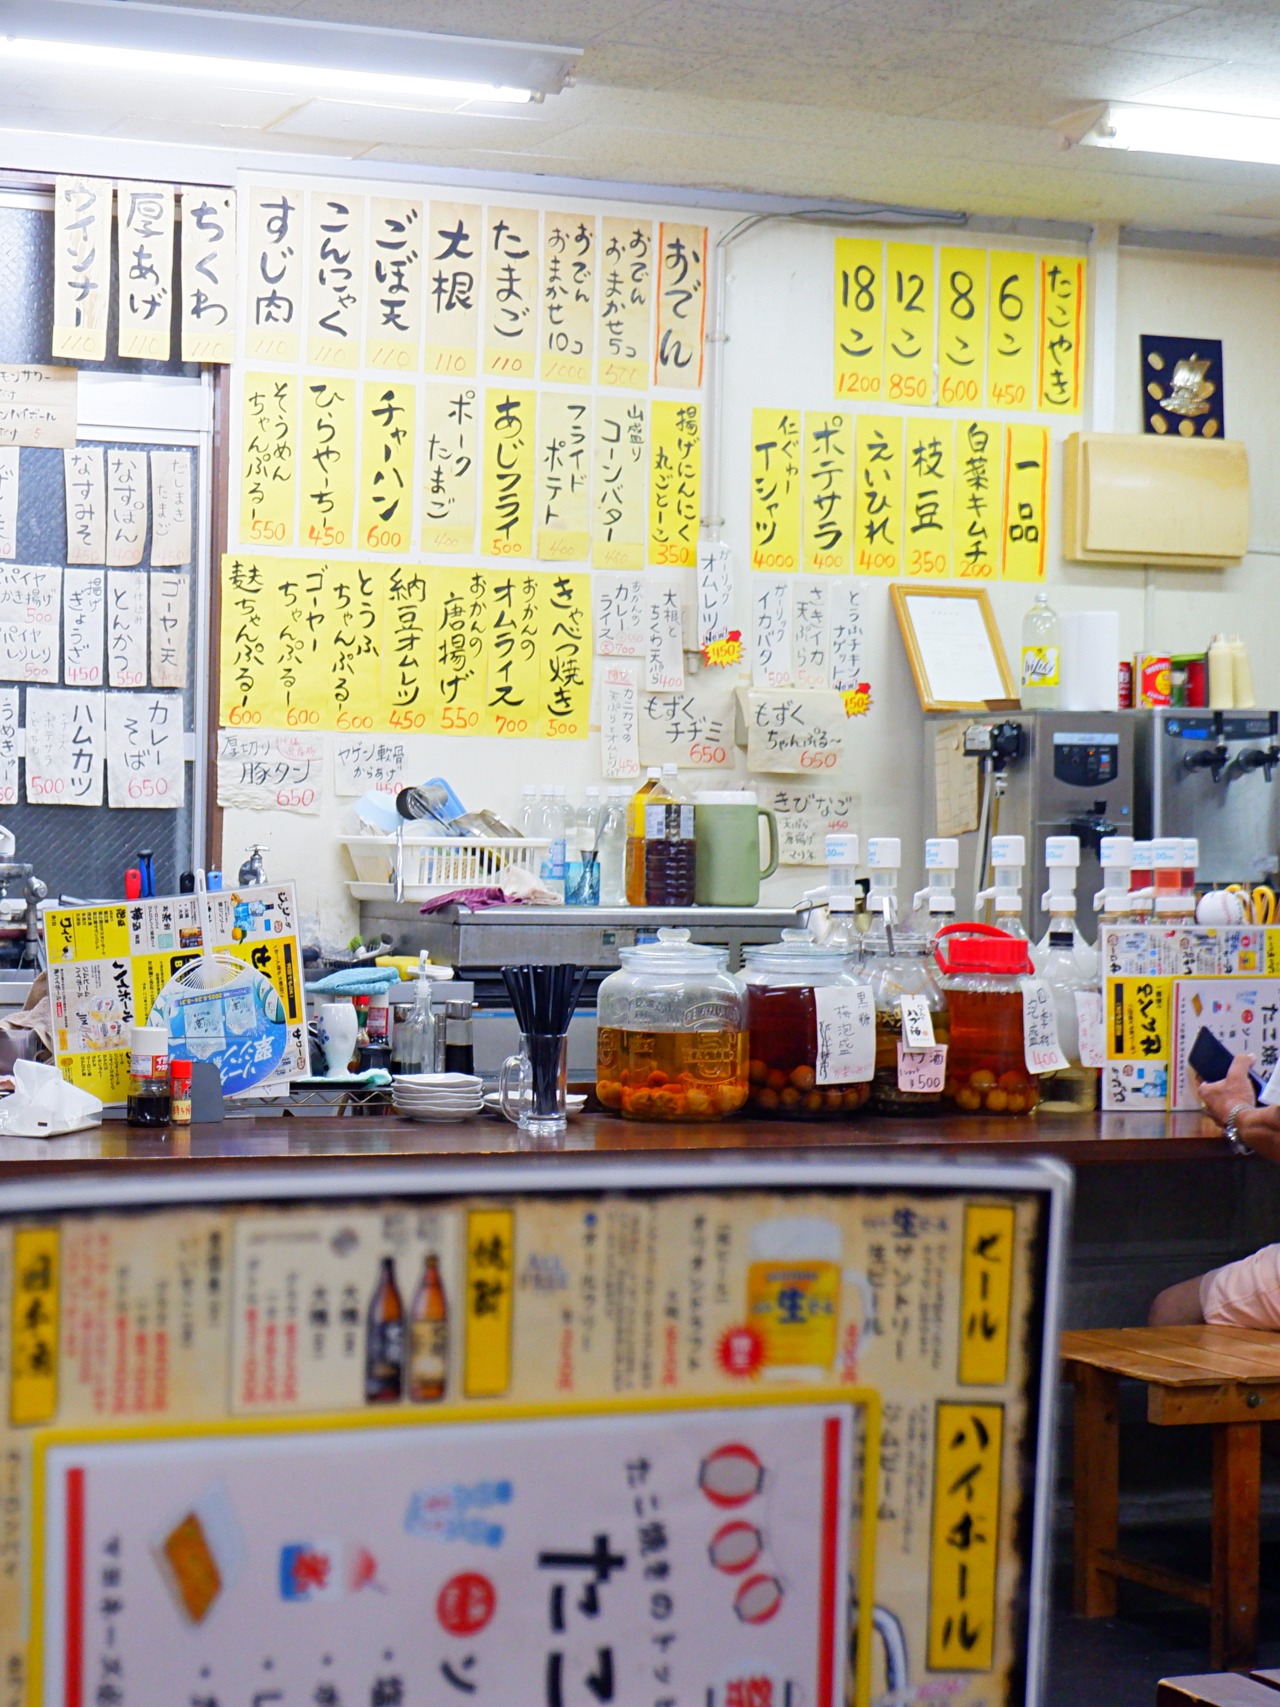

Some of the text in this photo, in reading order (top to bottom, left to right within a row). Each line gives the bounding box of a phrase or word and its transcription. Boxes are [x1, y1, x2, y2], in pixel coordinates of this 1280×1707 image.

[64, 182, 99, 327] ウインナー
[126, 193, 168, 321] 厚あげ
[189, 201, 229, 326] ちくわ
[255, 197, 296, 325] すじ肉
[318, 201, 357, 337] こんにゃく
[375, 208, 418, 332] ごぼ天
[431, 219, 474, 314] 大根
[493, 219, 531, 338] たまご
[659, 237, 701, 369] おでん
[1043, 265, 1073, 406] たこやき
[491, 354, 523, 373] 110
[837, 372, 881, 394] 1200
[888, 374, 927, 399] 850
[941, 377, 978, 402] 600
[991, 384, 1025, 405] 450
[370, 389, 405, 522] チャーハン
[447, 389, 476, 476] ポーク
[493, 394, 524, 540] あじフライ
[567, 403, 588, 493] フライド
[71, 453, 95, 546] なすみそ
[426, 434, 453, 519] たまご
[544, 439, 565, 525] ポテト
[600, 420, 623, 543] コーンバター
[675, 405, 701, 542] 揚げにんにく
[811, 417, 845, 550] ポテサラ
[863, 430, 895, 546] えいひれ
[910, 436, 945, 534] 枝豆
[963, 422, 990, 565] 白菜キムチ
[1009, 459, 1040, 544] 一品
[249, 520, 287, 542] 550
[308, 525, 345, 547] 450
[366, 524, 402, 549] 600
[656, 546, 690, 565] 350
[753, 550, 795, 569] 4000
[859, 549, 895, 569] 400
[910, 551, 946, 574] 350
[0, 588, 58, 608] かき揚げ
[158, 577, 186, 668] ゴーヤー天
[305, 566, 328, 653] ゴーヤー
[356, 568, 380, 658] とうふ
[468, 573, 488, 659] おかんの
[521, 576, 540, 662] おかんの
[700, 552, 719, 629] オムレツ
[6, 646, 52, 664] しりしり
[67, 591, 90, 664] ぎょうざ
[112, 589, 134, 672] とんかつ
[388, 567, 427, 707] 納豆オムレツ
[436, 592, 475, 705] 唐揚げ
[488, 576, 524, 708] オムライス
[547, 575, 586, 717] きゃべつ焼き
[68, 665, 99, 682] 450
[643, 694, 696, 721] もずく
[122, 717, 150, 772] そば
[147, 699, 169, 765] カレー
[220, 737, 272, 758] 厚切り
[229, 706, 263, 726] 600
[286, 708, 320, 727] 600
[336, 711, 374, 730] 600
[388, 708, 427, 729] 450
[439, 706, 480, 729] 550
[494, 714, 529, 734] 700
[546, 719, 579, 737] 500
[666, 719, 723, 744] チヂミ
[756, 699, 805, 727] もずく
[31, 775, 65, 795] 500
[70, 703, 94, 797] ハムカツ
[239, 759, 312, 786] 豚タン
[689, 742, 726, 765] 650
[800, 750, 838, 769] 650
[127, 778, 169, 799] 650
[275, 786, 316, 808] 650
[773, 790, 853, 818] きびなご
[59, 917, 73, 943] ワイン
[111, 959, 134, 1024] ハイボール
[1136, 983, 1163, 1057] せんべろ
[292, 1027, 303, 1056] サワー
[1031, 1051, 1059, 1068] 400
[964, 1232, 1003, 1342] ビール
[939, 1412, 991, 1652] ハイボール
